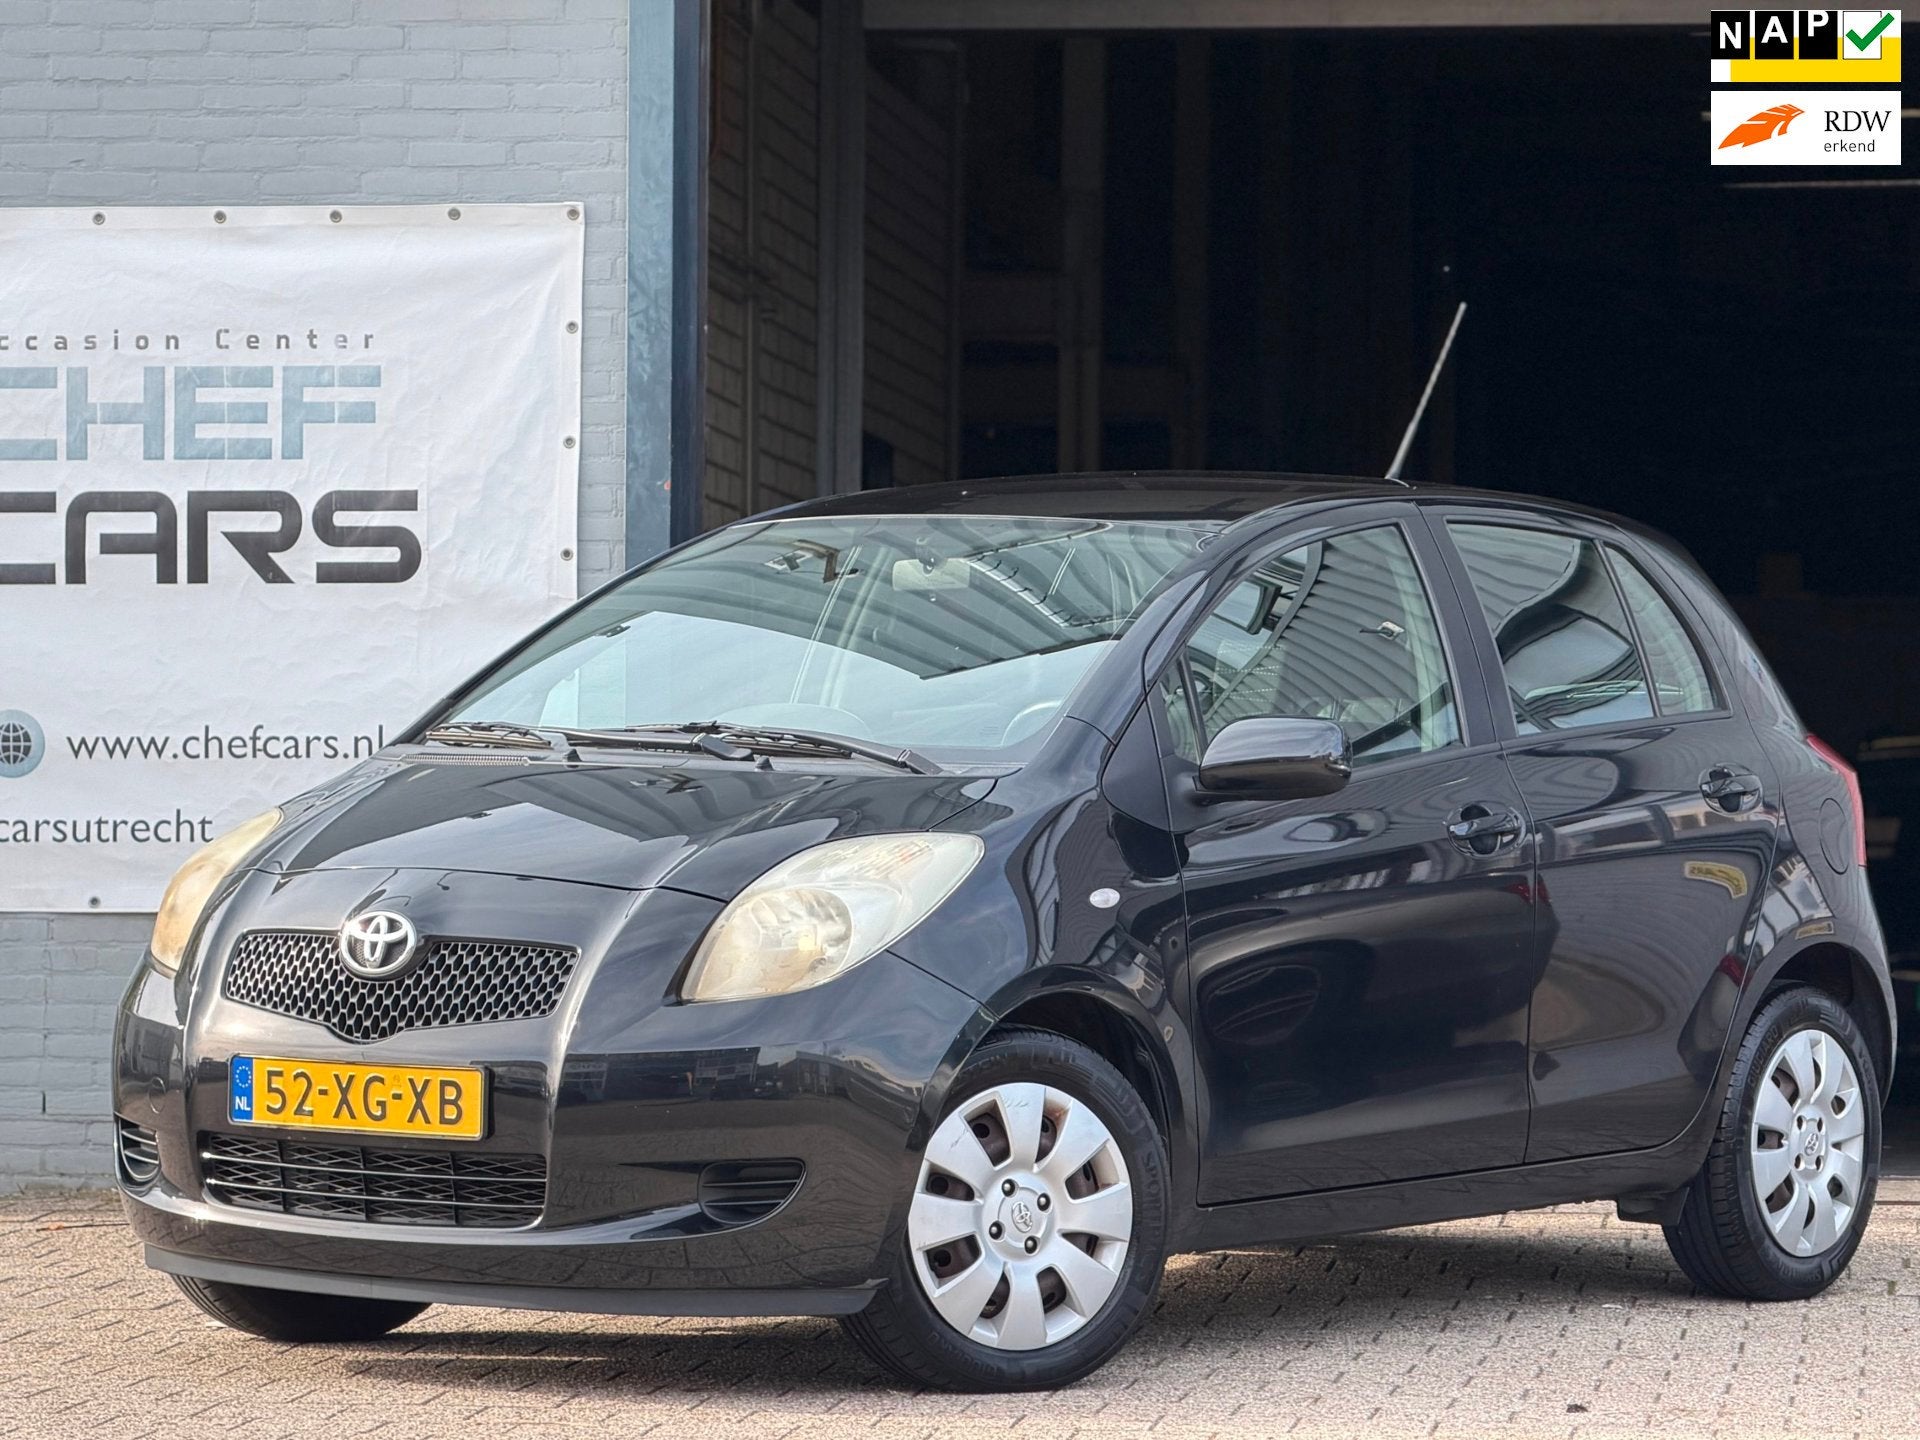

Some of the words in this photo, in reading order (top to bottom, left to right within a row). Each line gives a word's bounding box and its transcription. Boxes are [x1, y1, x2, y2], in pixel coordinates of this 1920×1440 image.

[215, 327, 375, 350] Center
[234, 1095, 251, 1112] NL
[265, 1068, 464, 1126] 52-XG-XB
